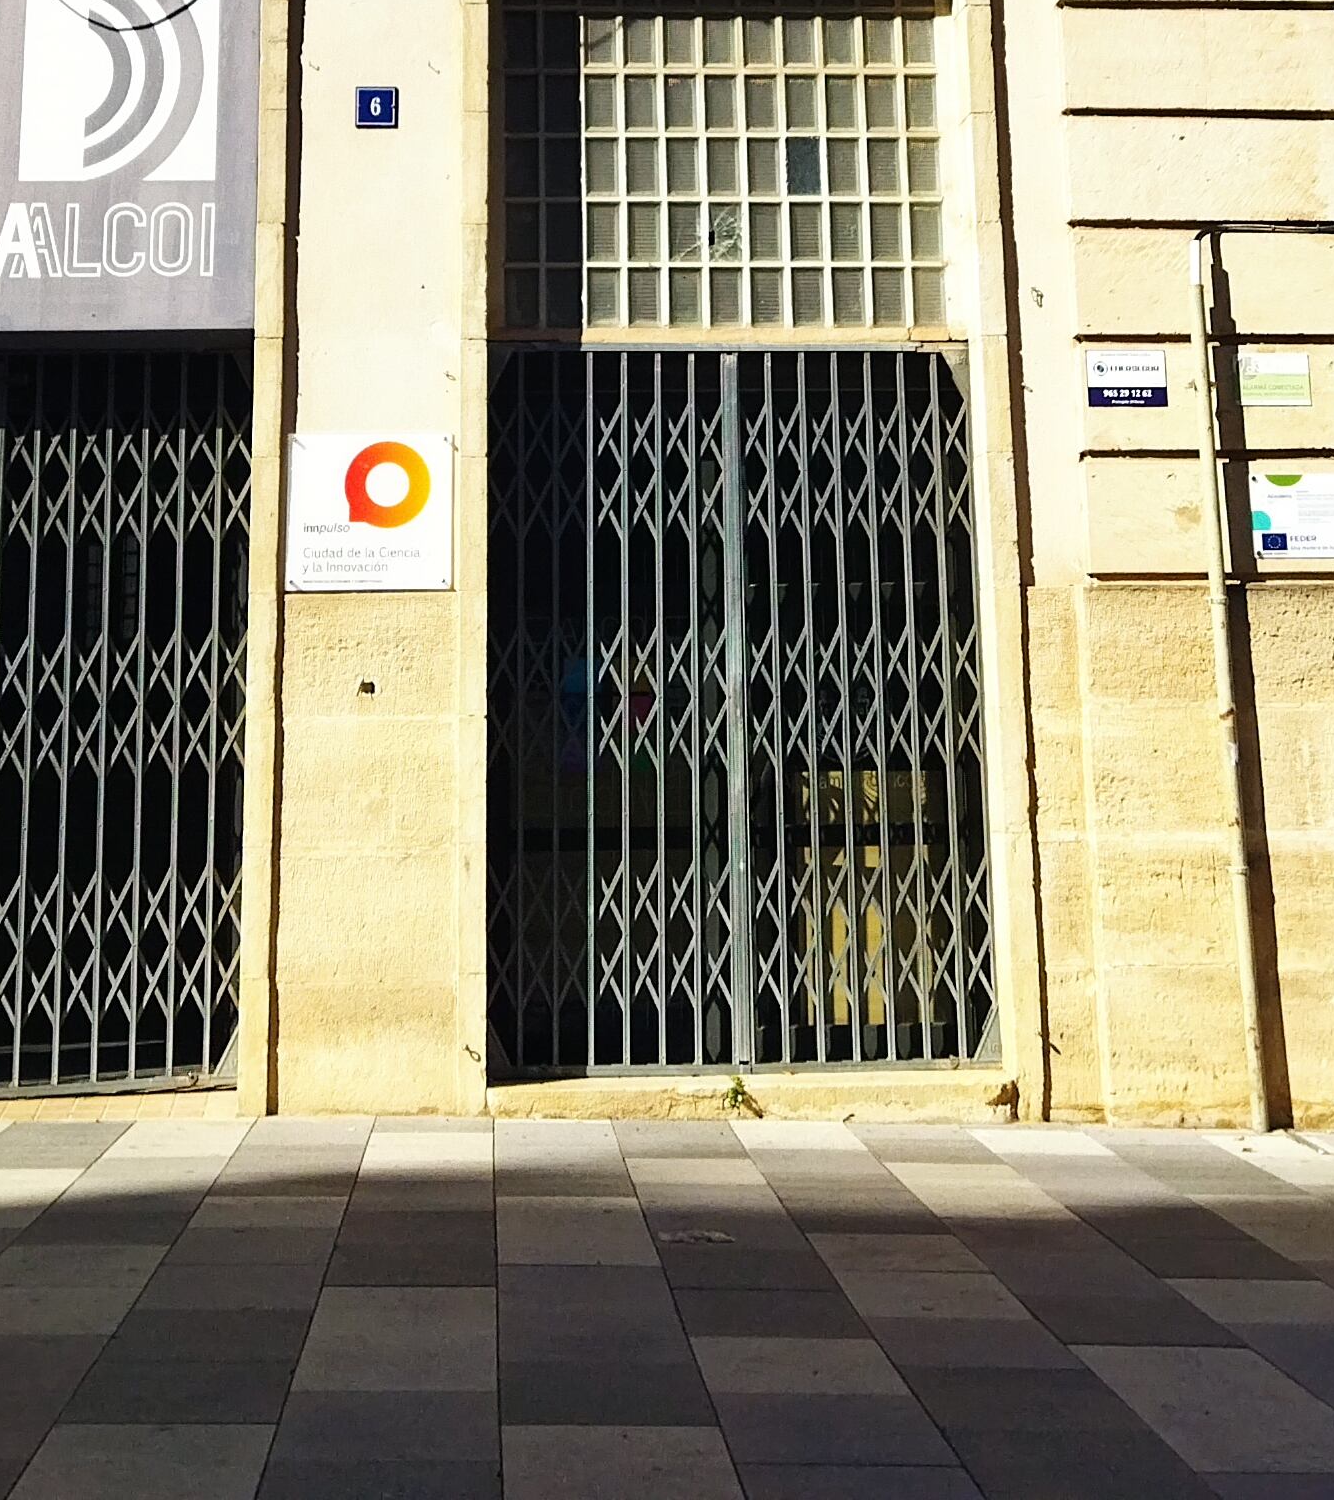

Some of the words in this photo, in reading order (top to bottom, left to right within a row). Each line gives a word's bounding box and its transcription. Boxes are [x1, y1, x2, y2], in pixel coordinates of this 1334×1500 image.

[370, 96, 381, 116] 6
[9, 202, 215, 278] ALCOI
[303, 522, 351, 534] innpulso
[303, 547, 343, 558] Ciudad
[347, 547, 361, 558] de
[365, 547, 375, 558] la
[379, 546, 420, 558] Ciencia
[302, 563, 309, 575] y
[312, 561, 323, 572] la
[326, 561, 388, 573] Innovación
